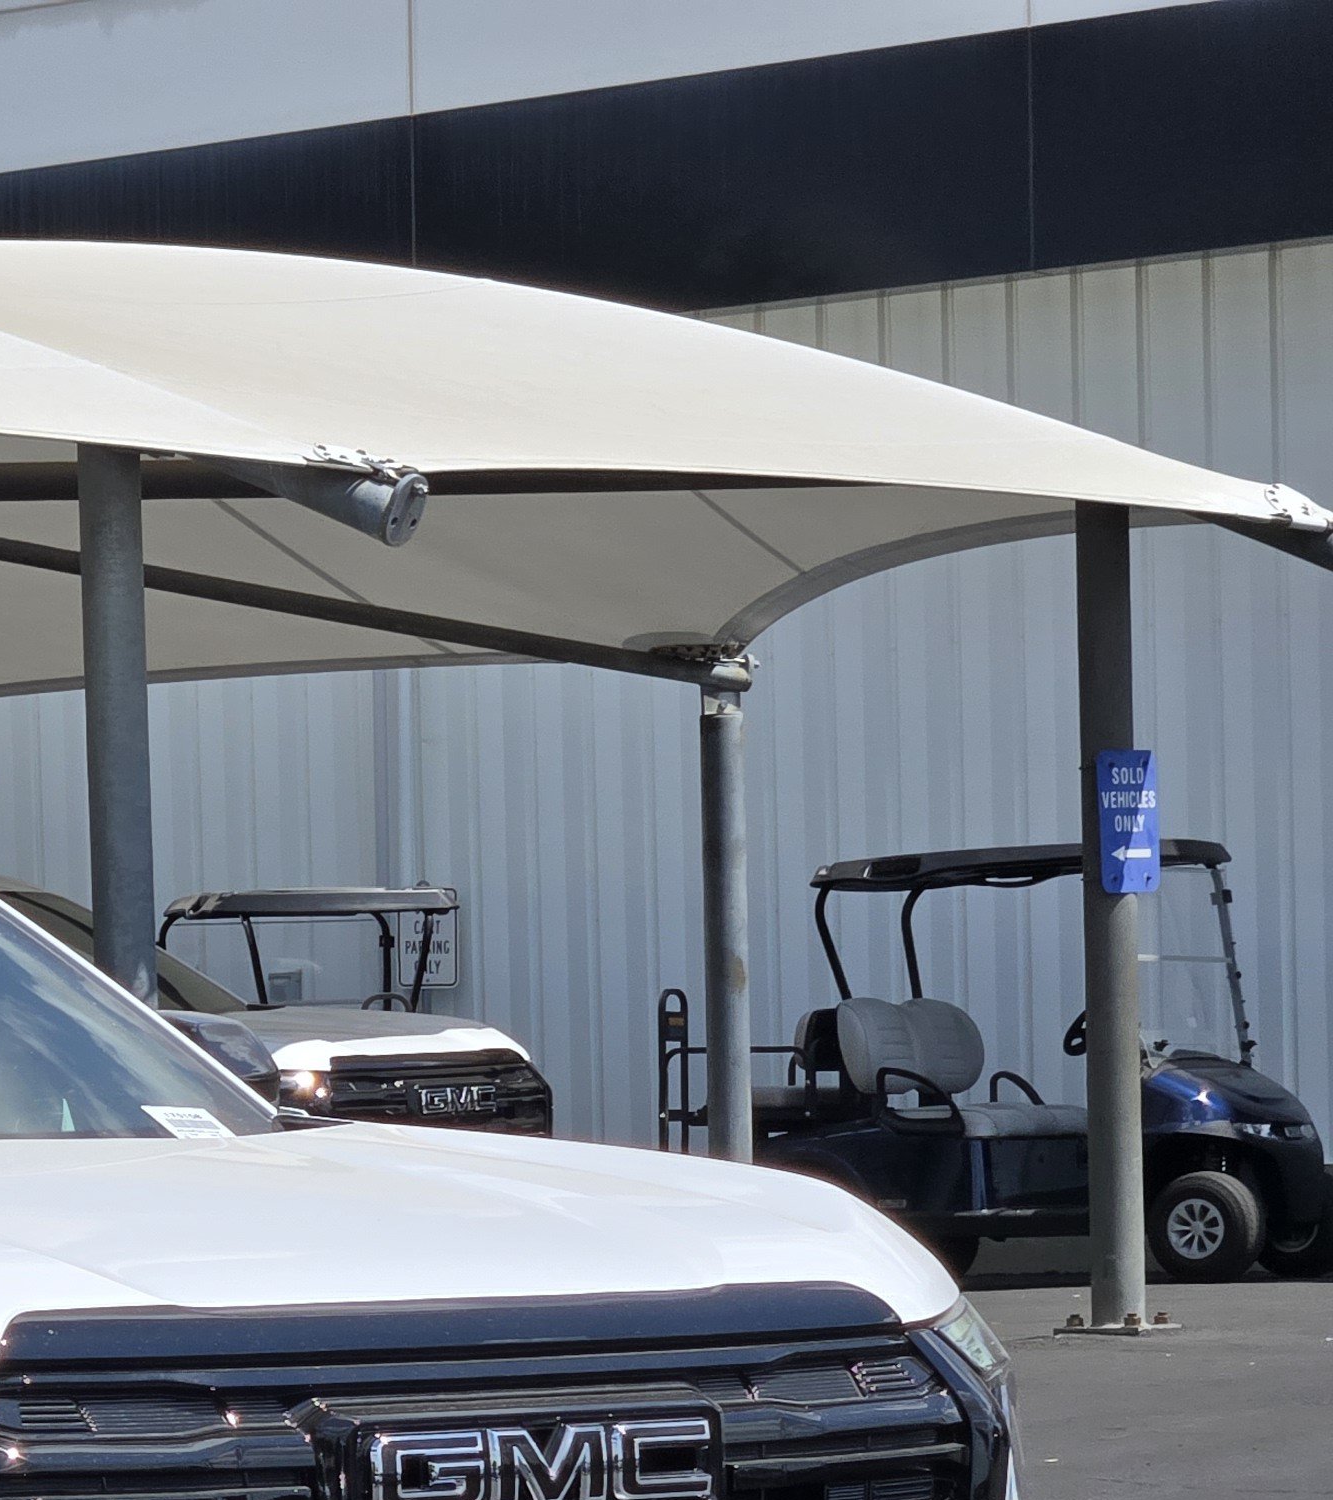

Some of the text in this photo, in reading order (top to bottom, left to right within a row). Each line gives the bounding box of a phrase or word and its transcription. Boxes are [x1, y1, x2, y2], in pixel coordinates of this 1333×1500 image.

[1112, 767, 1144, 784] SOLD
[1102, 791, 1156, 809] VEHICLES
[1115, 815, 1145, 832] ONLY
[414, 920, 441, 934] CT
[405, 941, 450, 954] PARING
[421, 1085, 496, 1114] GMC
